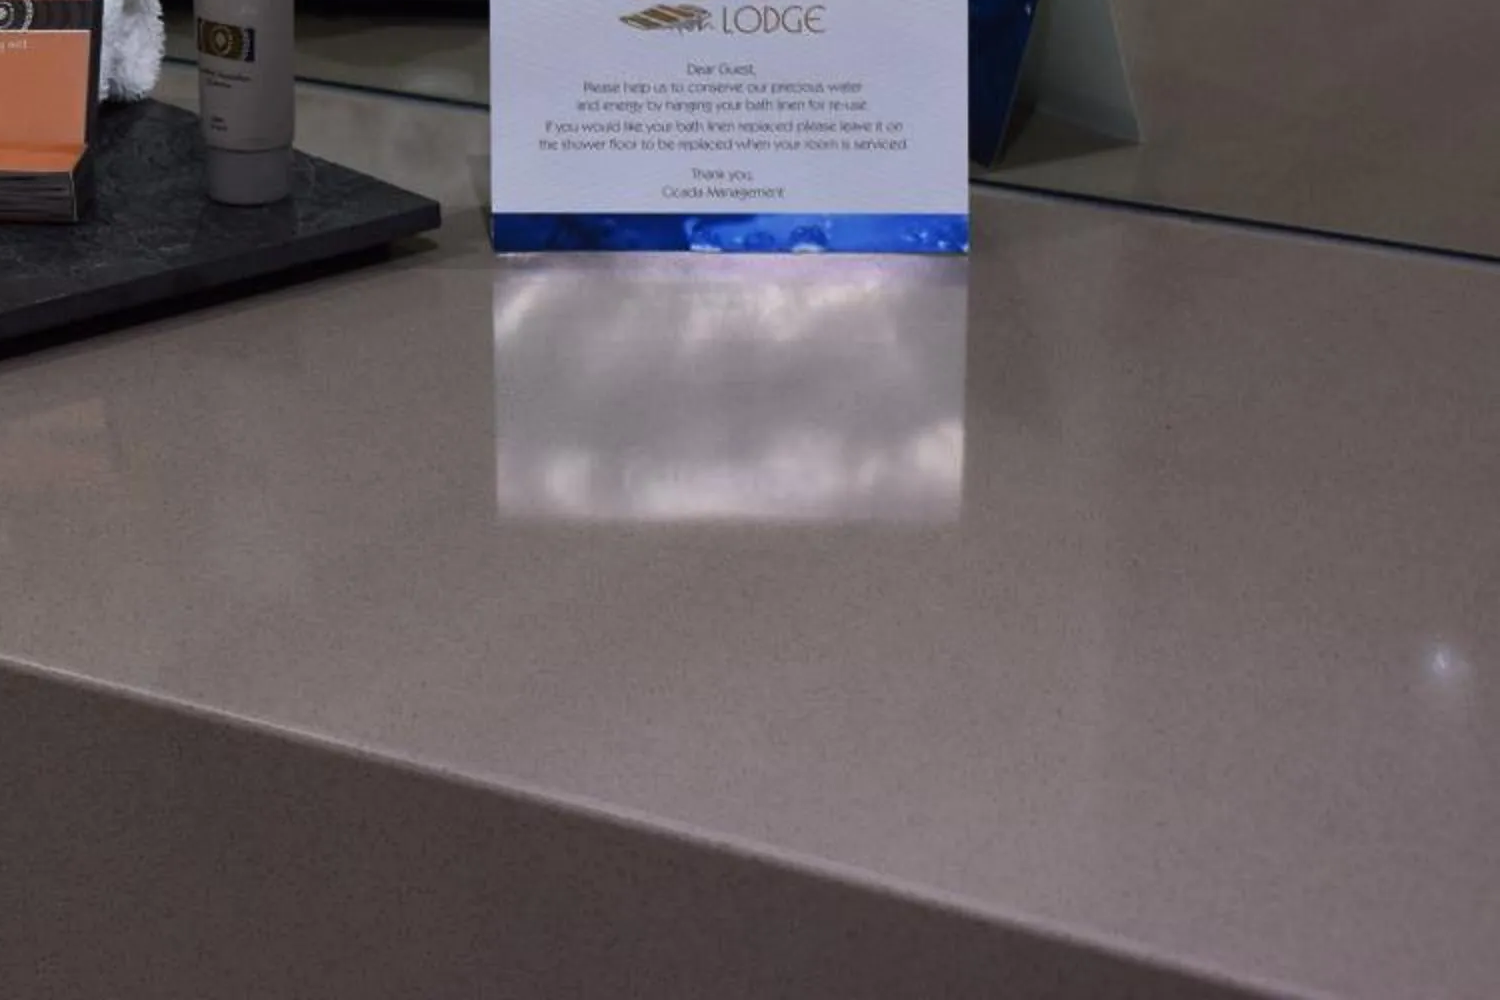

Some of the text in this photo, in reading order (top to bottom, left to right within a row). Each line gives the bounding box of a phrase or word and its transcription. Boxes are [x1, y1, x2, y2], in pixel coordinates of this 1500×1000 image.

[721, 4, 827, 34] LODGE
[686, 63, 716, 76] Dear
[583, 81, 863, 95] Please help us to conserve our precious water
[576, 99, 600, 111] and
[603, 101, 643, 113] energy
[646, 99, 663, 113] by
[665, 99, 713, 113] hanging
[715, 101, 742, 113] your
[745, 99, 773, 111] bath
[777, 99, 805, 111] linen
[808, 99, 825, 111] for
[545, 120, 904, 135] If you would like your bath linen replaced please leave it on
[538, 138, 559, 150] the
[561, 138, 606, 150] shower
[609, 138, 638, 150] floor
[641, 138, 655, 150] to
[657, 138, 675, 150] be
[677, 138, 733, 152] replaced
[734, 138, 771, 150] when
[773, 140, 801, 152] your
[804, 140, 838, 150] room
[841, 138, 851, 150] is
[691, 168, 725, 180] Thank
[662, 184, 785, 201] Cicada Management
